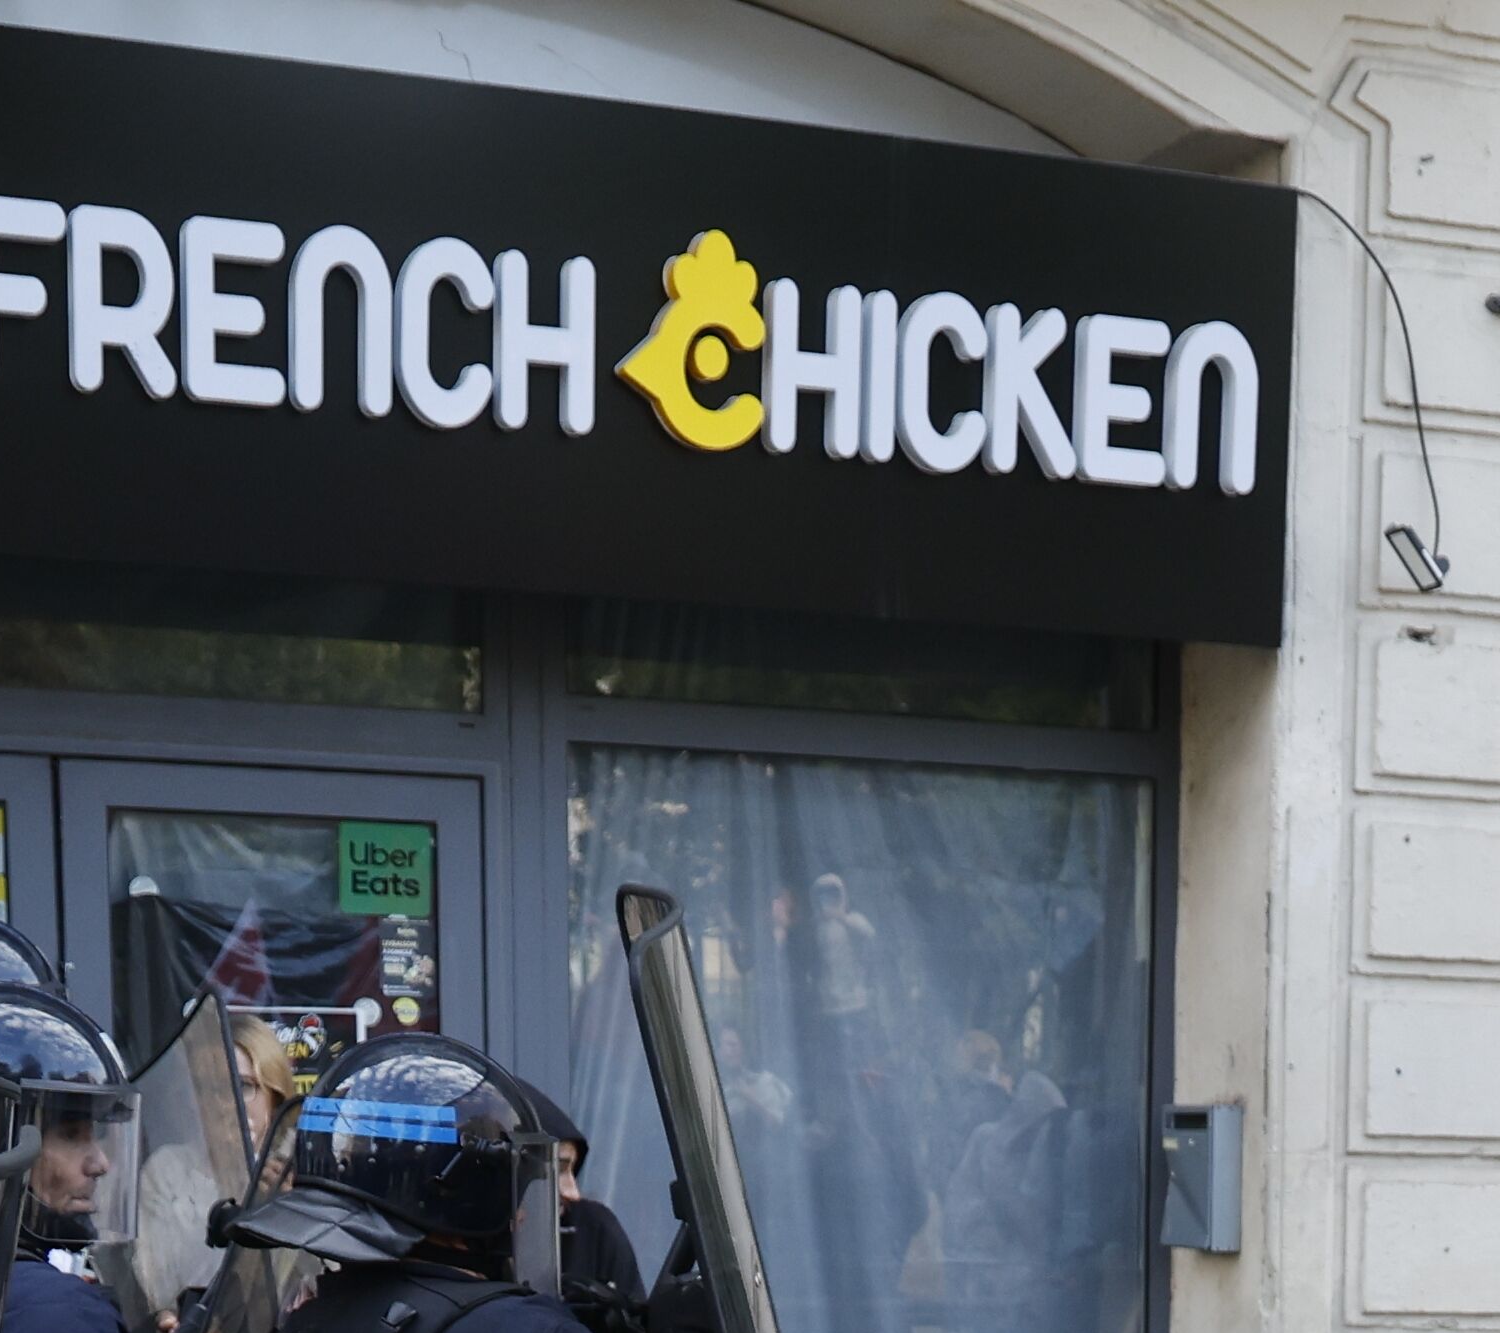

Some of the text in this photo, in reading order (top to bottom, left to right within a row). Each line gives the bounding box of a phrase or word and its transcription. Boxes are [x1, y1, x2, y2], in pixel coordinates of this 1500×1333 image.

[614, 229, 1260, 496] CHICKEN
[349, 840, 417, 867] Uber
[351, 869, 420, 897] Eats
